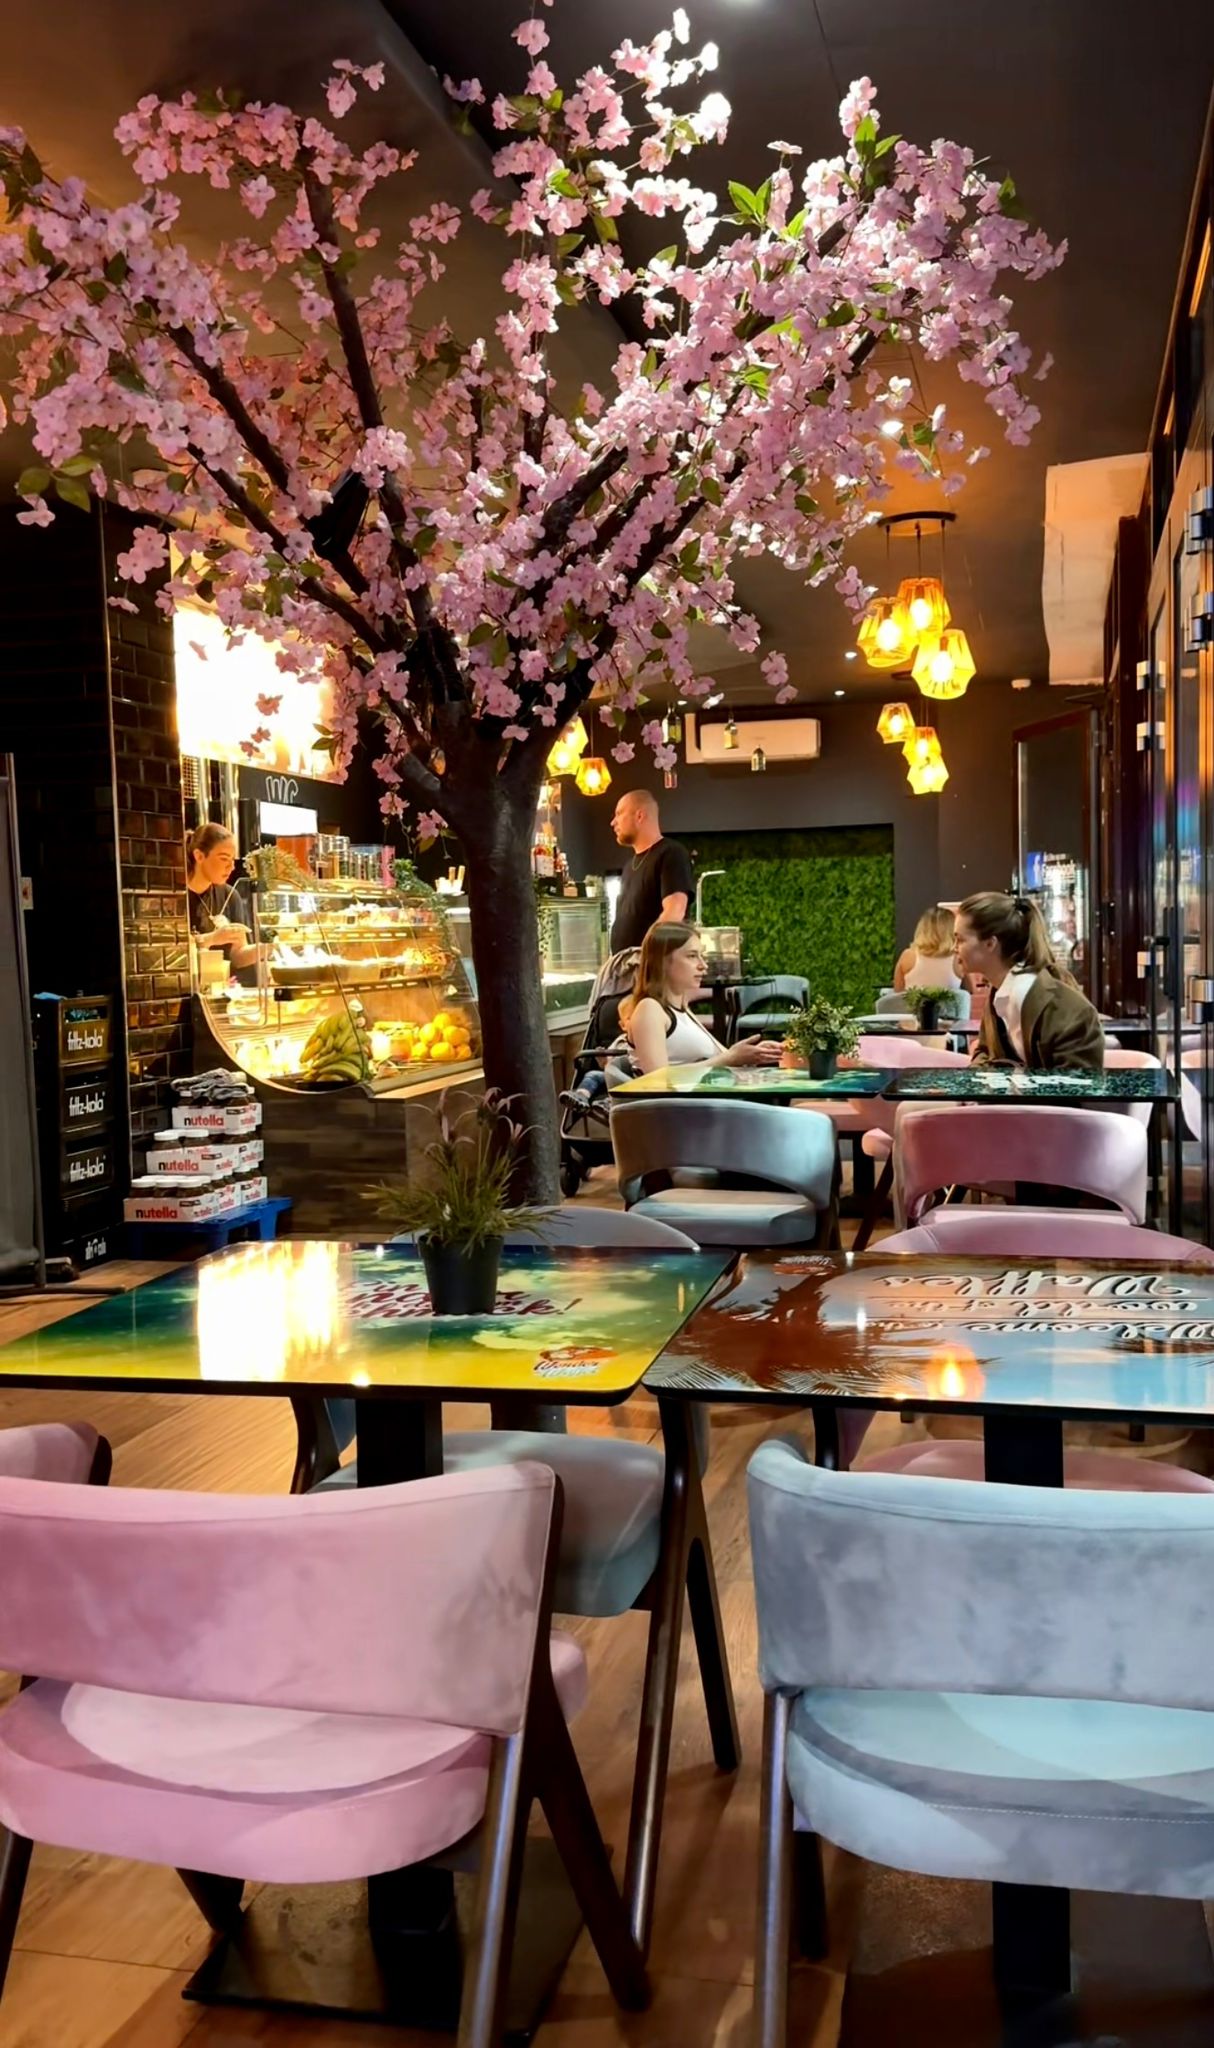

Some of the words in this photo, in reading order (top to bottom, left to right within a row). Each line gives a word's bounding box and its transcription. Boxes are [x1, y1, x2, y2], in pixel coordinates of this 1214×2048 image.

[67, 1029, 103, 1051] fritz-kola
[69, 1092, 104, 1117] fritz-kola
[184, 1115, 224, 1126] nutella
[70, 1156, 105, 1183] fritz-kola
[158, 1159, 199, 1172] nutella
[135, 1206, 178, 1219] nutella
[875, 1271, 1191, 1297] Waffles
[1009, 1300, 1198, 1318] world
[960, 1321, 1214, 1339] Welcome
